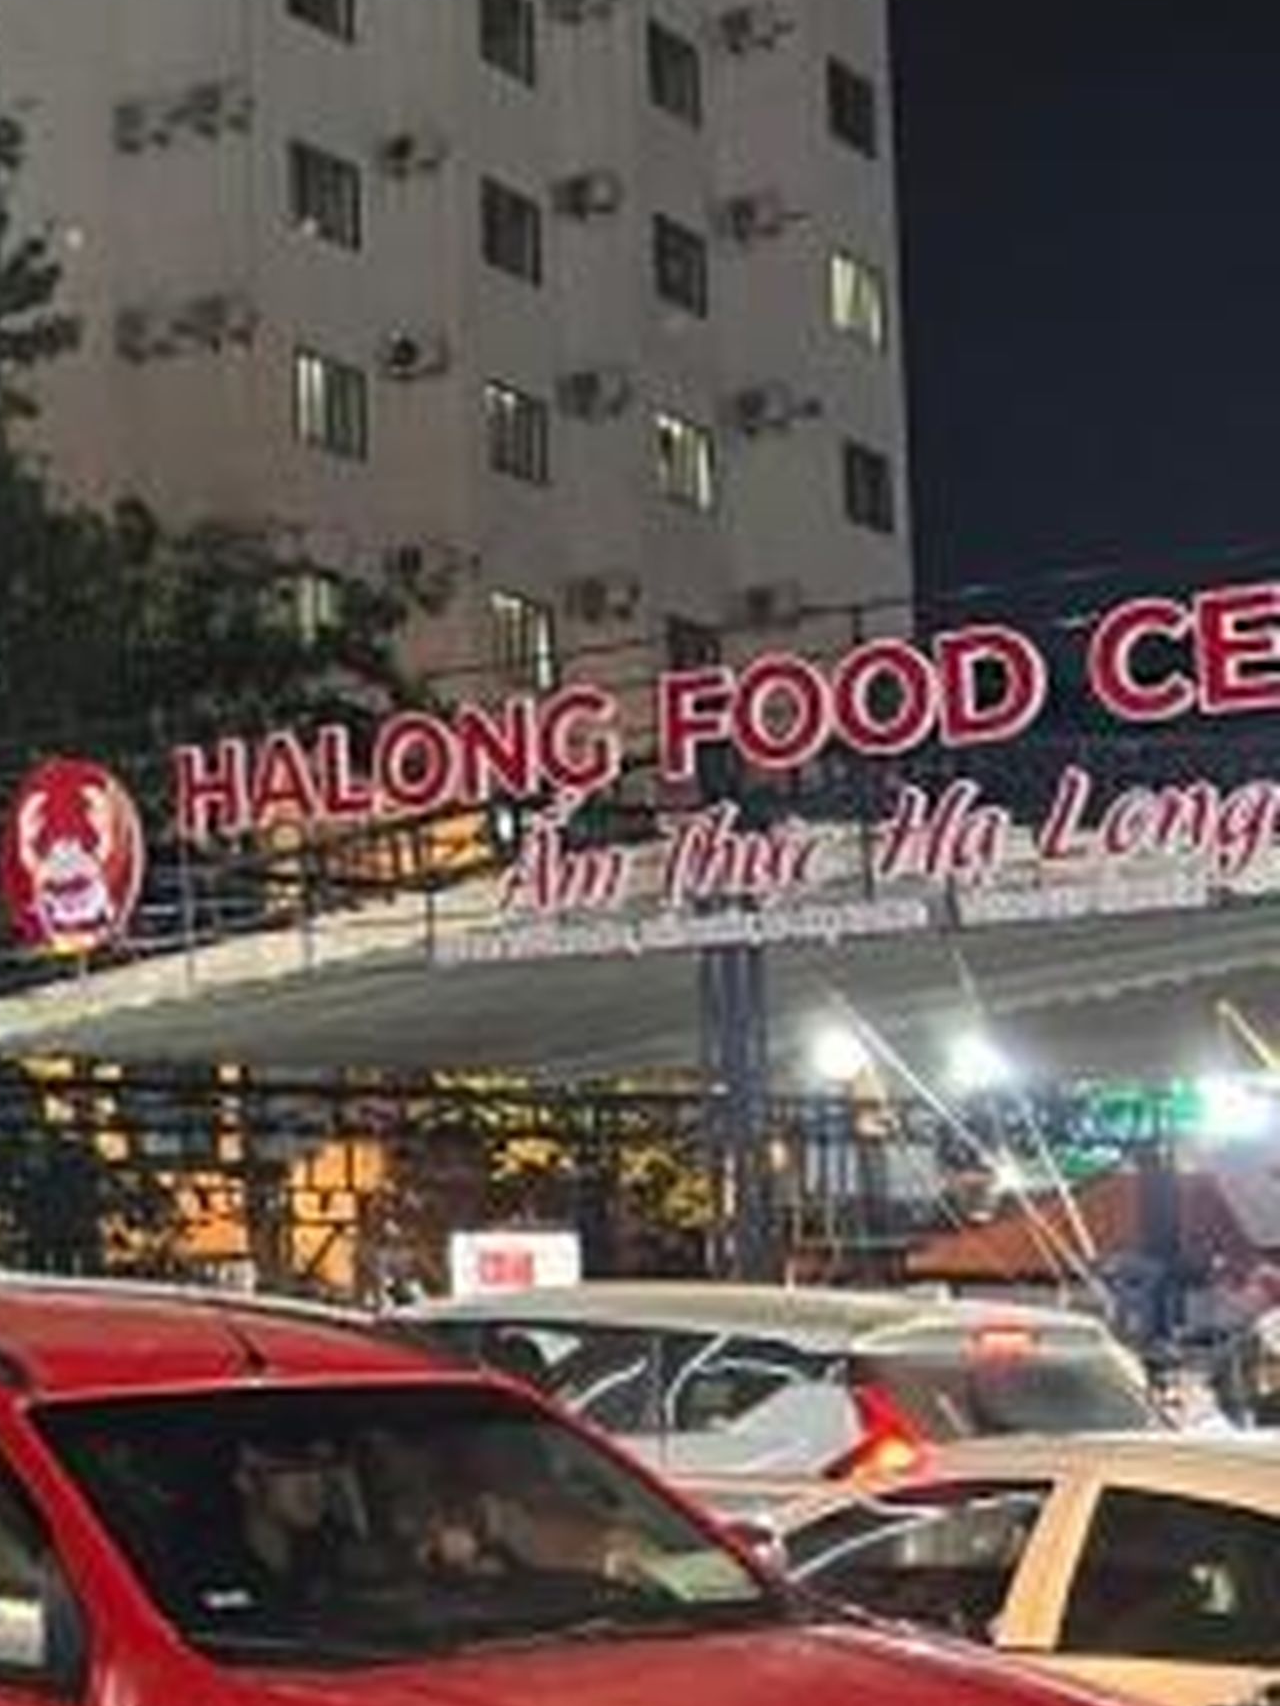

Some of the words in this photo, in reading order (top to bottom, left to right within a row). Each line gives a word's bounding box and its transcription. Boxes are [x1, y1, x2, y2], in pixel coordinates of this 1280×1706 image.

[173, 683, 621, 845] HALONG
[658, 621, 1046, 781] FOOD
[1088, 583, 1280, 723] CE
[1037, 764, 1280, 877] Long
